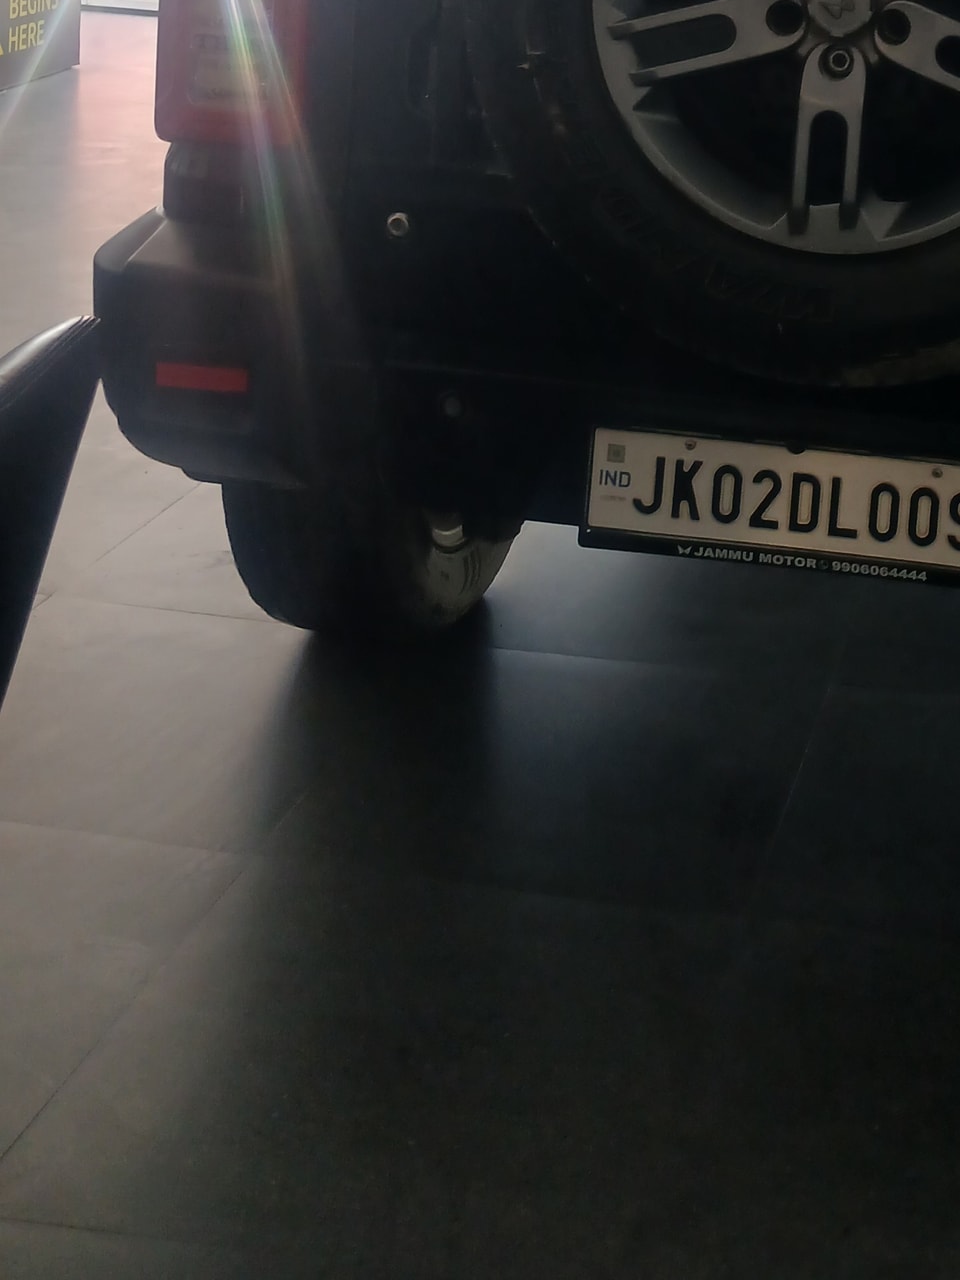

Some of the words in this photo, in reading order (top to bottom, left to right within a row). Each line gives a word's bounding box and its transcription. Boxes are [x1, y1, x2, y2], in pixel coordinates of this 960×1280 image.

[8, 19, 46, 53] HERE
[599, 468, 632, 488] IND
[693, 547, 754, 563] JAMMU
[758, 553, 817, 569] MOTOR
[831, 561, 928, 582] 9906064444
